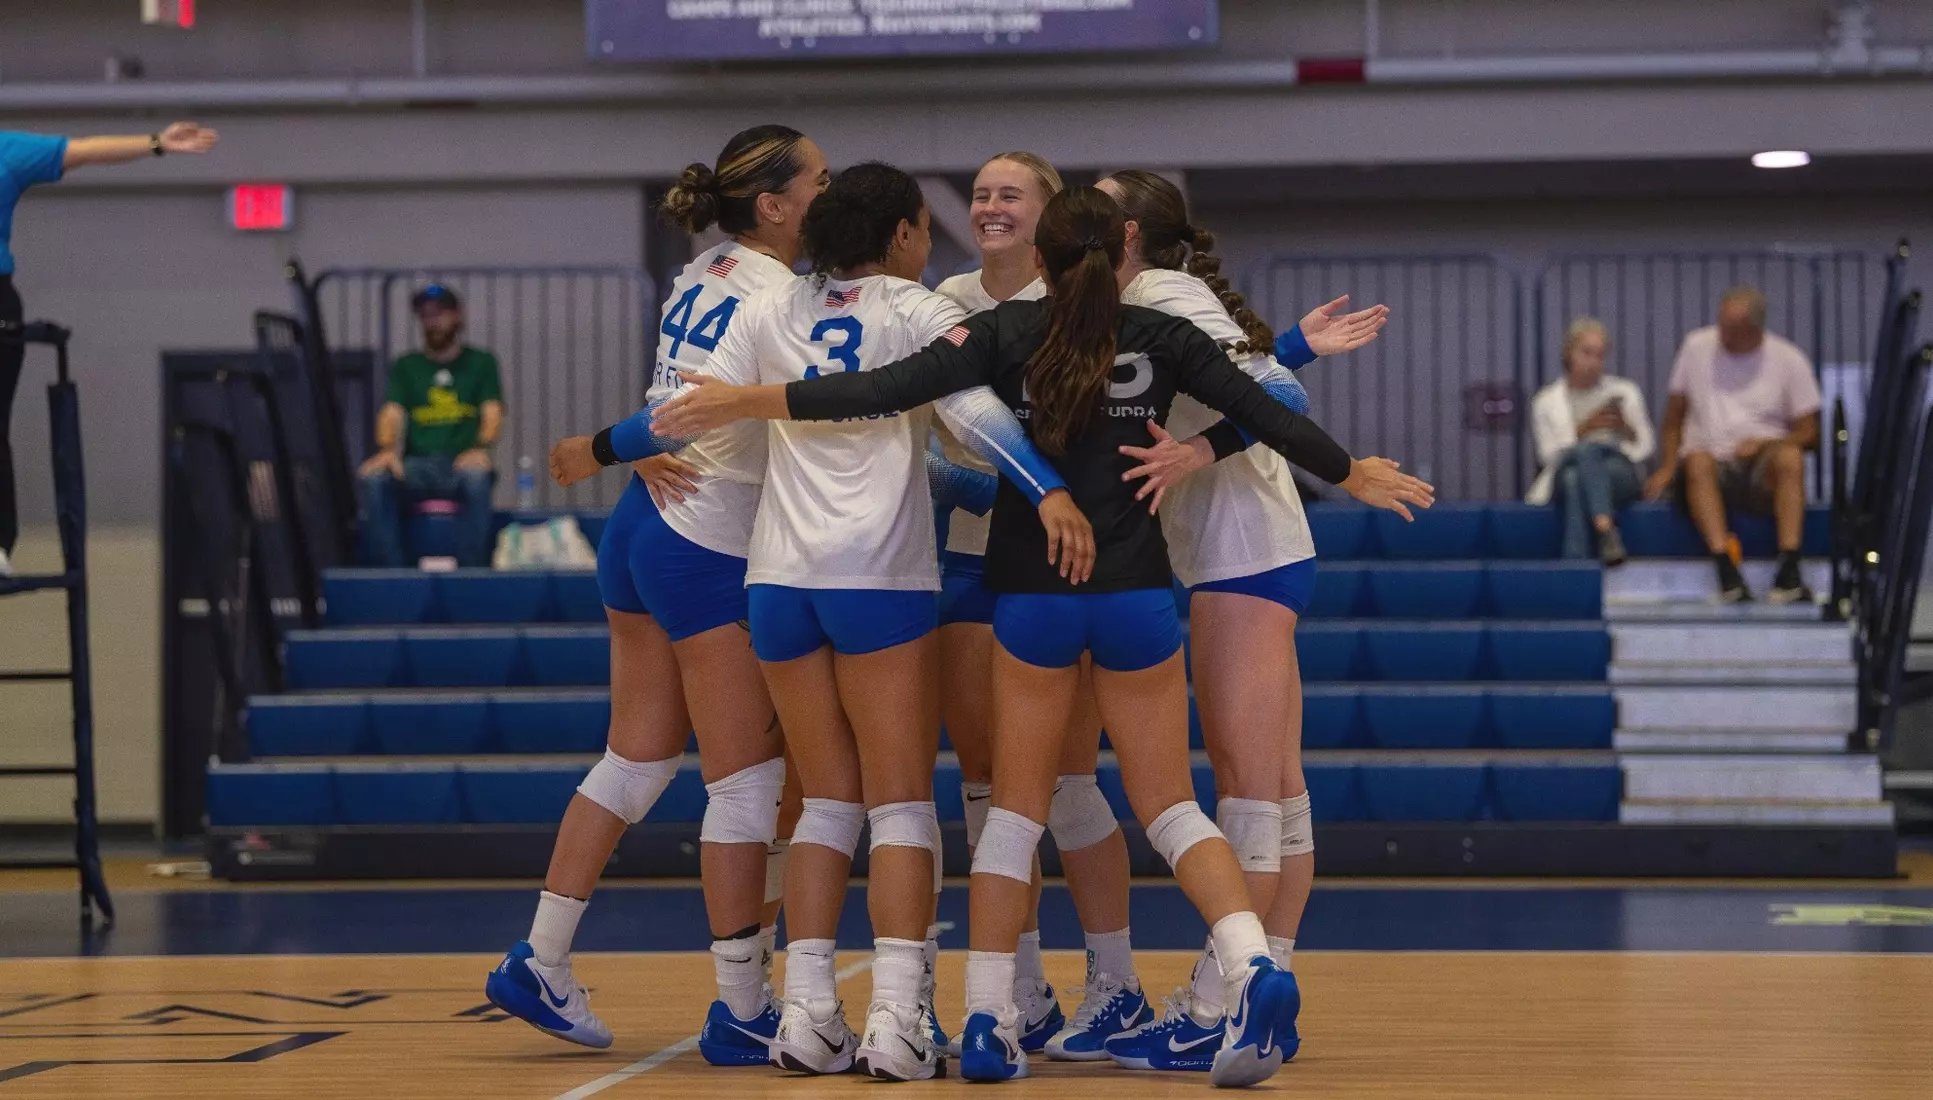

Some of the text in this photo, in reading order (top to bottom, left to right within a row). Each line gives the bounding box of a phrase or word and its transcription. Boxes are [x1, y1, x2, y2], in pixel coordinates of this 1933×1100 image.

[662, 283, 740, 360] 44
[804, 315, 863, 380] 3
[1101, 406, 1157, 420] UPRA
